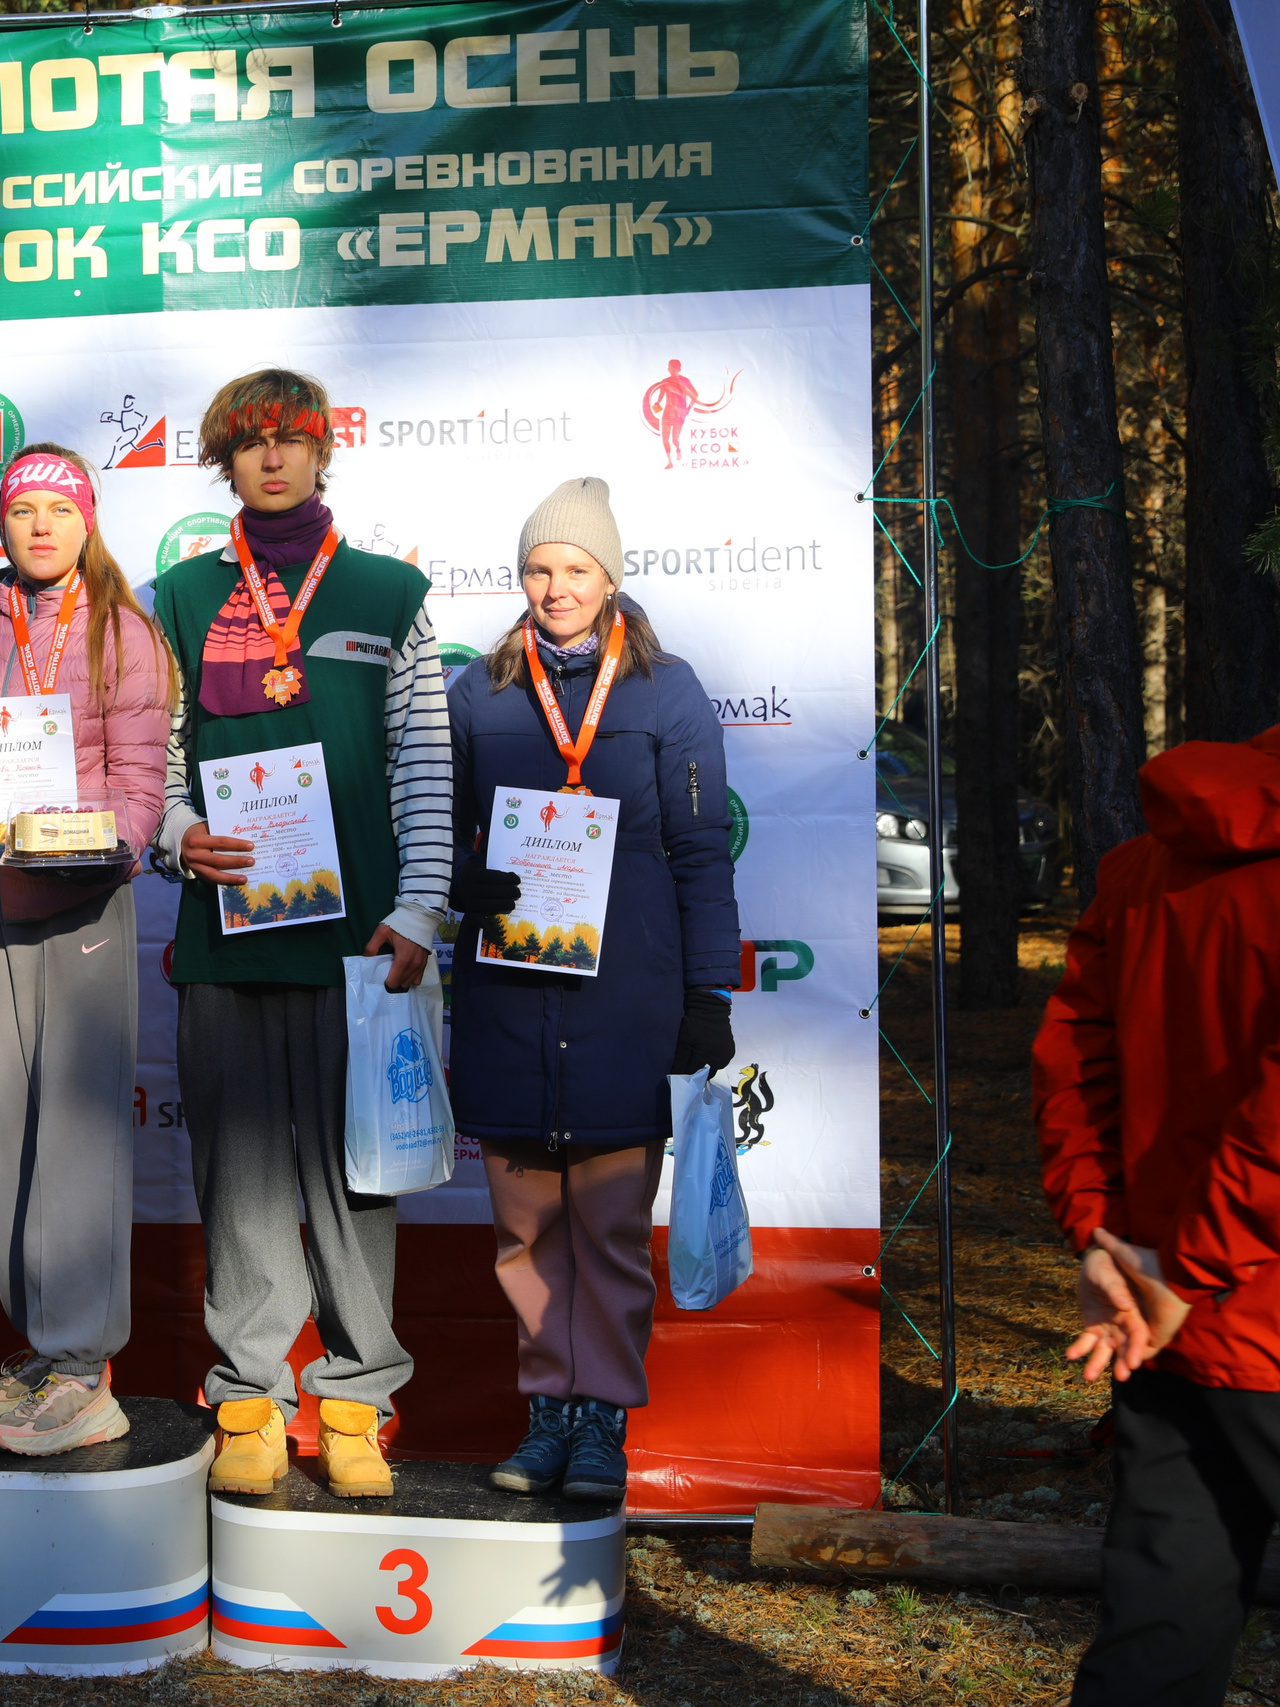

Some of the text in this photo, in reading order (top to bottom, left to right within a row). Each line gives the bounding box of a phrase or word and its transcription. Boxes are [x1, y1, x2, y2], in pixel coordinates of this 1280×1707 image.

[365, 23, 740, 114] ОСЕНЬ
[293, 142, 712, 194] СОРЕВНОВАНИЯ
[142, 216, 301, 274] КСО
[336, 201, 713, 266] «ЕРМАК»
[378, 409, 573, 448] SPORTident
[690, 426, 739, 439] КУБОК
[682, 457, 750, 469] «ЕРМАК»
[690, 443, 721, 454] КСО
[161, 516, 232, 565] ФЕДЕРАЦИЯ СПОРТИВНО
[624, 537, 822, 577] SPORTident
[249, 563, 276, 626] ЗОЛОТАЯ ОСЕНЬ
[297, 555, 330, 611] ЗОЛОТАЯ ОСЕНЬ
[428, 560, 521, 598] Ерма
[708, 577, 782, 592] siberia
[47, 623, 69, 689] ЗОЛОТАЯ ОСЕНЬ
[438, 647, 477, 660] ОРТИВНОГ
[29, 669, 42, 696] ЛОТАЯ
[541, 678, 556, 707] ОСЕНЬ
[588, 657, 618, 727] ЗОЛОТАЯ ОСЕНЬ
[713, 686, 792, 721] рмак
[551, 706, 571, 744] ЗОЛОТАЯ
[240, 793, 298, 814] ДИПЛОМ
[247, 811, 297, 823] НАГРАЖДАЕТСЯ
[274, 827, 297, 835] место
[520, 835, 583, 852] ДИПЛОМ
[525, 852, 576, 864] НАГРАЖДАЕТСЯ
[374, 1548, 433, 1636] 3
